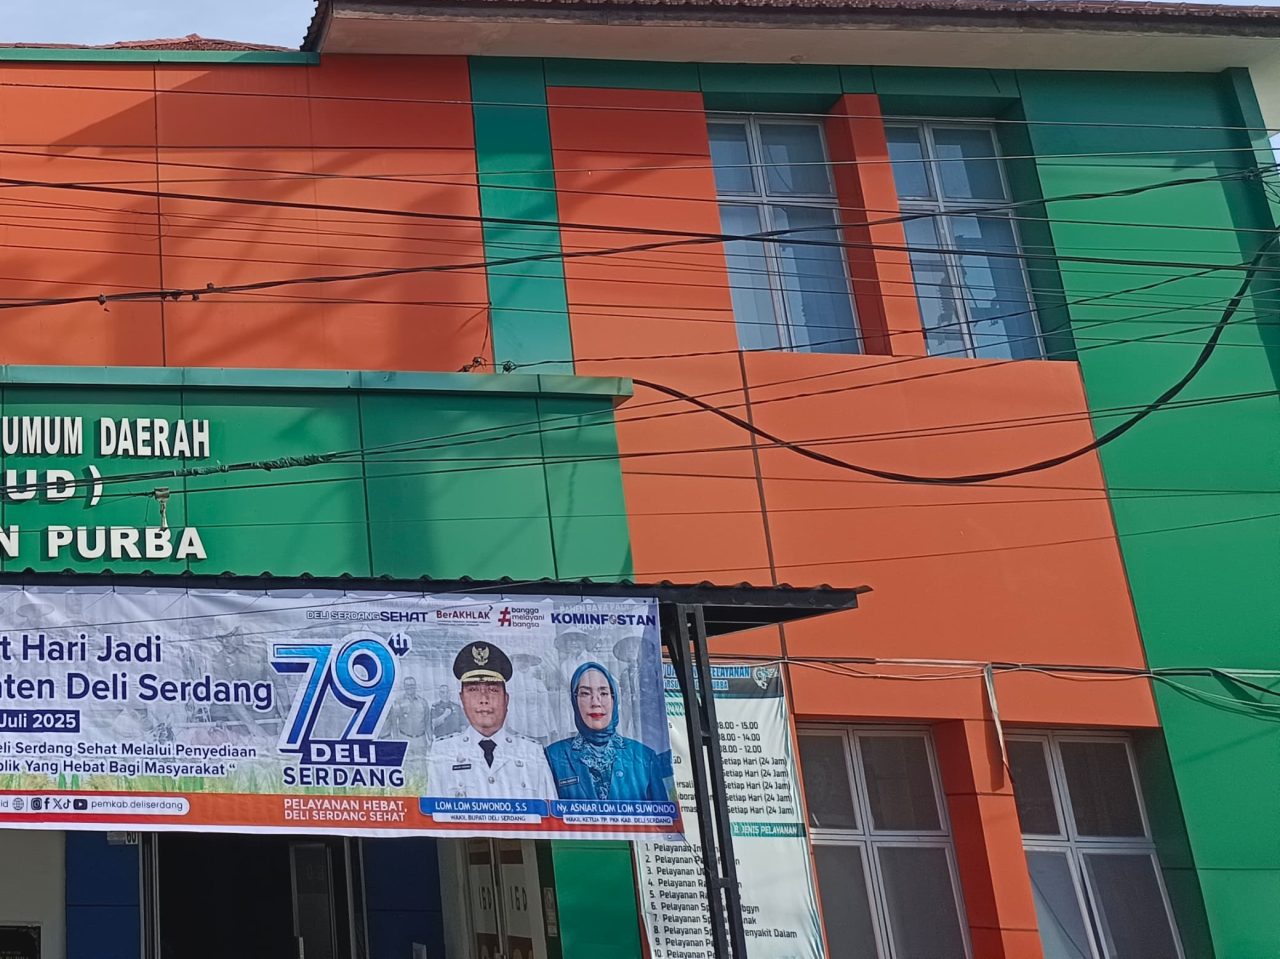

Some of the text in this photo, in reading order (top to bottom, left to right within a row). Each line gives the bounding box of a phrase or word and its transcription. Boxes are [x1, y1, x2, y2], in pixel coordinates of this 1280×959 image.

[2, 416, 83, 455] UMUM
[100, 417, 210, 458] DAERAH
[48, 526, 207, 560] PURBA
[306, 611, 329, 620] DELI
[436, 610, 490, 620] BerAKHLAK
[511, 607, 539, 615] bangga
[512, 614, 544, 622] melayani
[512, 621, 539, 629] bangsa
[22, 634, 87, 661] Hari
[97, 635, 161, 662] Jadi
[712, 666, 751, 678] ELAYANAN
[67, 672, 127, 700] Deli
[138, 673, 272, 710] Serdang
[33, 714, 76, 728] 2025
[719, 722, 758, 730] 8.00 15.00
[720, 733, 736, 741] 8.00
[15, 742, 72, 756] Serdang
[77, 742, 117, 755] Sehat
[121, 743, 171, 756] Melalui
[176, 744, 256, 759] Penyediaan
[310, 743, 377, 763] DELI
[744, 745, 762, 753] 12.00
[759, 757, 770, 767] (24
[771, 757, 787, 766] Jam)
[25, 760, 58, 774] Yang
[63, 760, 105, 773] Hebat
[110, 761, 140, 776] Bagi
[144, 761, 225, 776] Masyarakat
[283, 767, 404, 787] SERDANG
[761, 770, 771, 779] (24
[773, 770, 789, 779] Jam)
[763, 782, 773, 791] (24
[775, 782, 791, 791] Jam)
[764, 794, 775, 803] (24
[777, 794, 792, 803] Jam)
[91, 800, 183, 811] pemkab.deliserdang
[284, 799, 359, 810] PELAYANAN
[435, 801, 452, 810] LOM
[454, 802, 470, 811] LOM
[556, 803, 568, 813] Ny.
[570, 804, 597, 812] ASNIAR
[598, 804, 615, 813] LOM
[617, 804, 634, 813] LOM
[636, 804, 675, 813] SUWONDO
[284, 810, 405, 822] DELI SERDANG SEHAT
[766, 806, 777, 815] (24
[778, 807, 794, 815] Jam)
[741, 825, 760, 834] JENIS
[761, 826, 797, 834] PELAYANAN
[654, 843, 691, 854] Pelayanan
[655, 855, 693, 865] Pelayanan
[656, 866, 695, 877] Pelayanan
[658, 878, 696, 889] Pelayanan
[660, 890, 698, 901] Pelayanan
[661, 902, 699, 914] Pelayanan
[741, 905, 760, 915] bgyn
[663, 914, 701, 926] Pelayanan
[743, 916, 757, 925] nak
[664, 926, 702, 937] Pelayanan
[745, 929, 773, 939] enyakit
[774, 928, 798, 939] Dalam
[665, 937, 704, 948] Pelayanan
